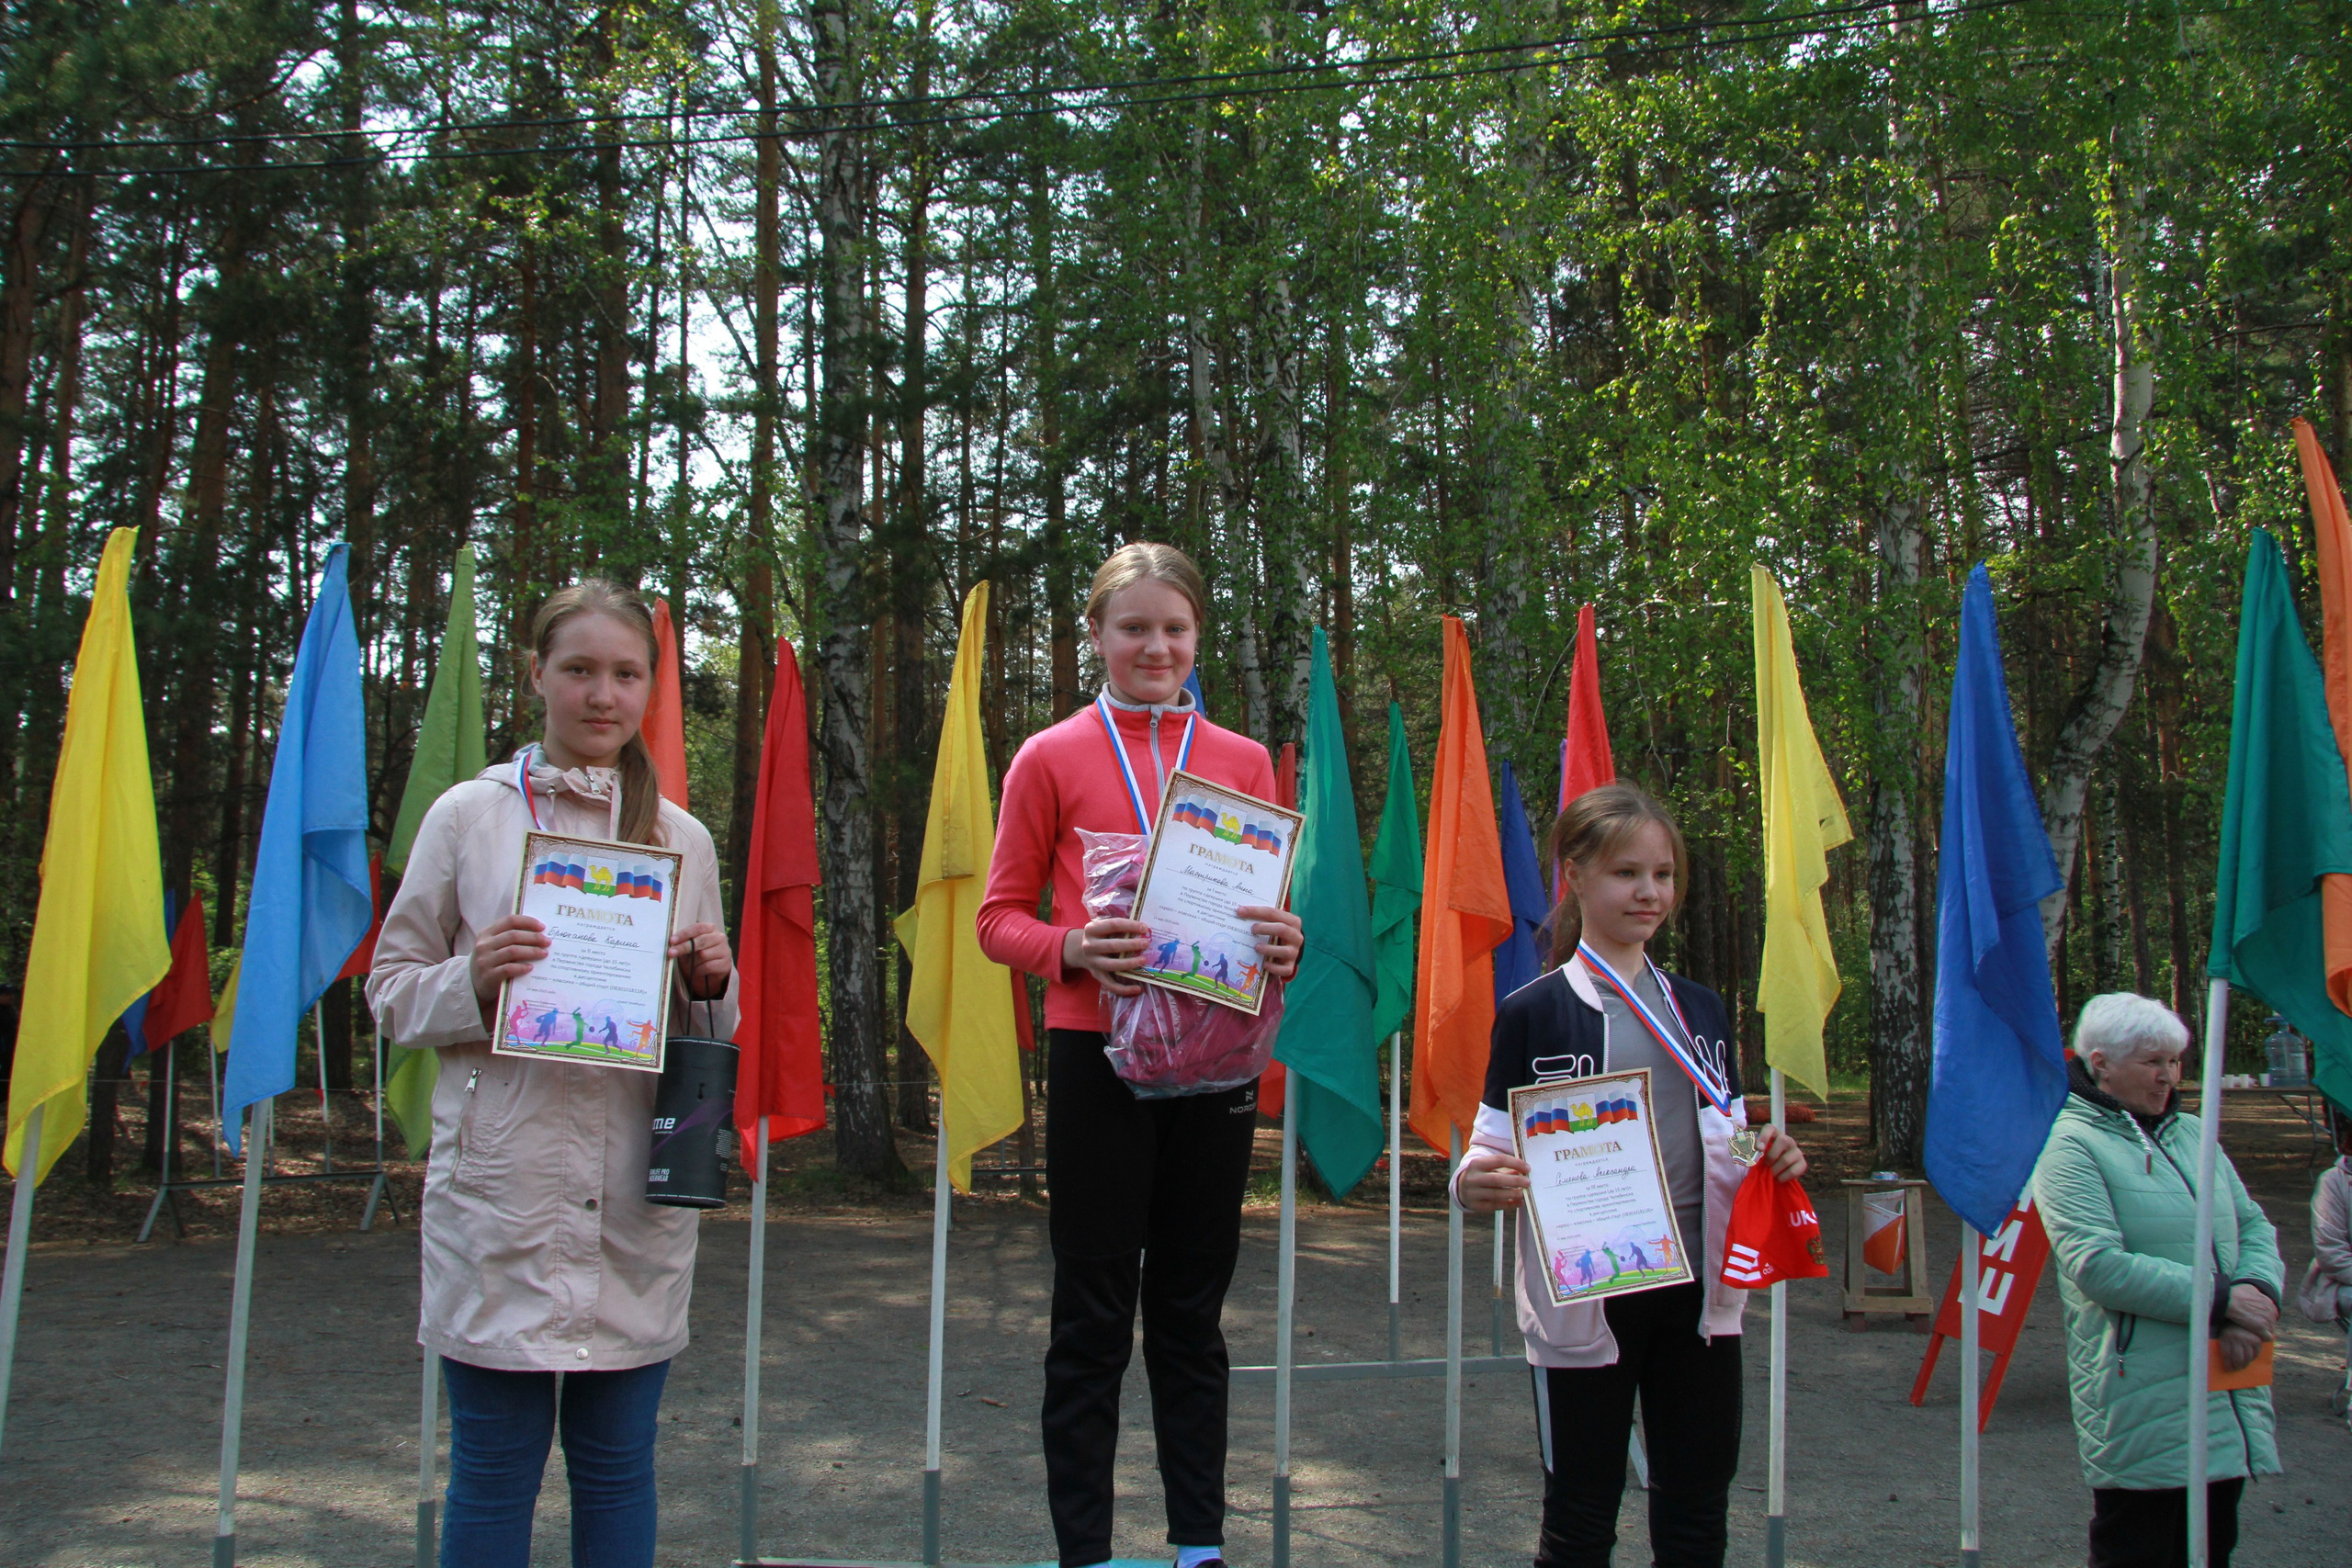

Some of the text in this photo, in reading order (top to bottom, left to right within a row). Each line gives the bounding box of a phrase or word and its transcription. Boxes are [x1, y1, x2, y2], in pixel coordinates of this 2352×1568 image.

[1189, 843, 1254, 874] ГРАМОТА
[1205, 863, 1238, 875] награждается
[1188, 887, 1202, 896] группе
[1184, 899, 1211, 910] спортивному
[1208, 900, 1222, 908] города
[557, 904, 634, 926] ГРАМОТА
[1178, 909, 1196, 919] классика
[1200, 910, 1225, 921] дисциплине
[577, 922, 616, 931] награждается
[605, 935, 639, 949] Карина
[590, 970, 630, 978] ориентированию
[1554, 1141, 1623, 1161] ГРАМОТА
